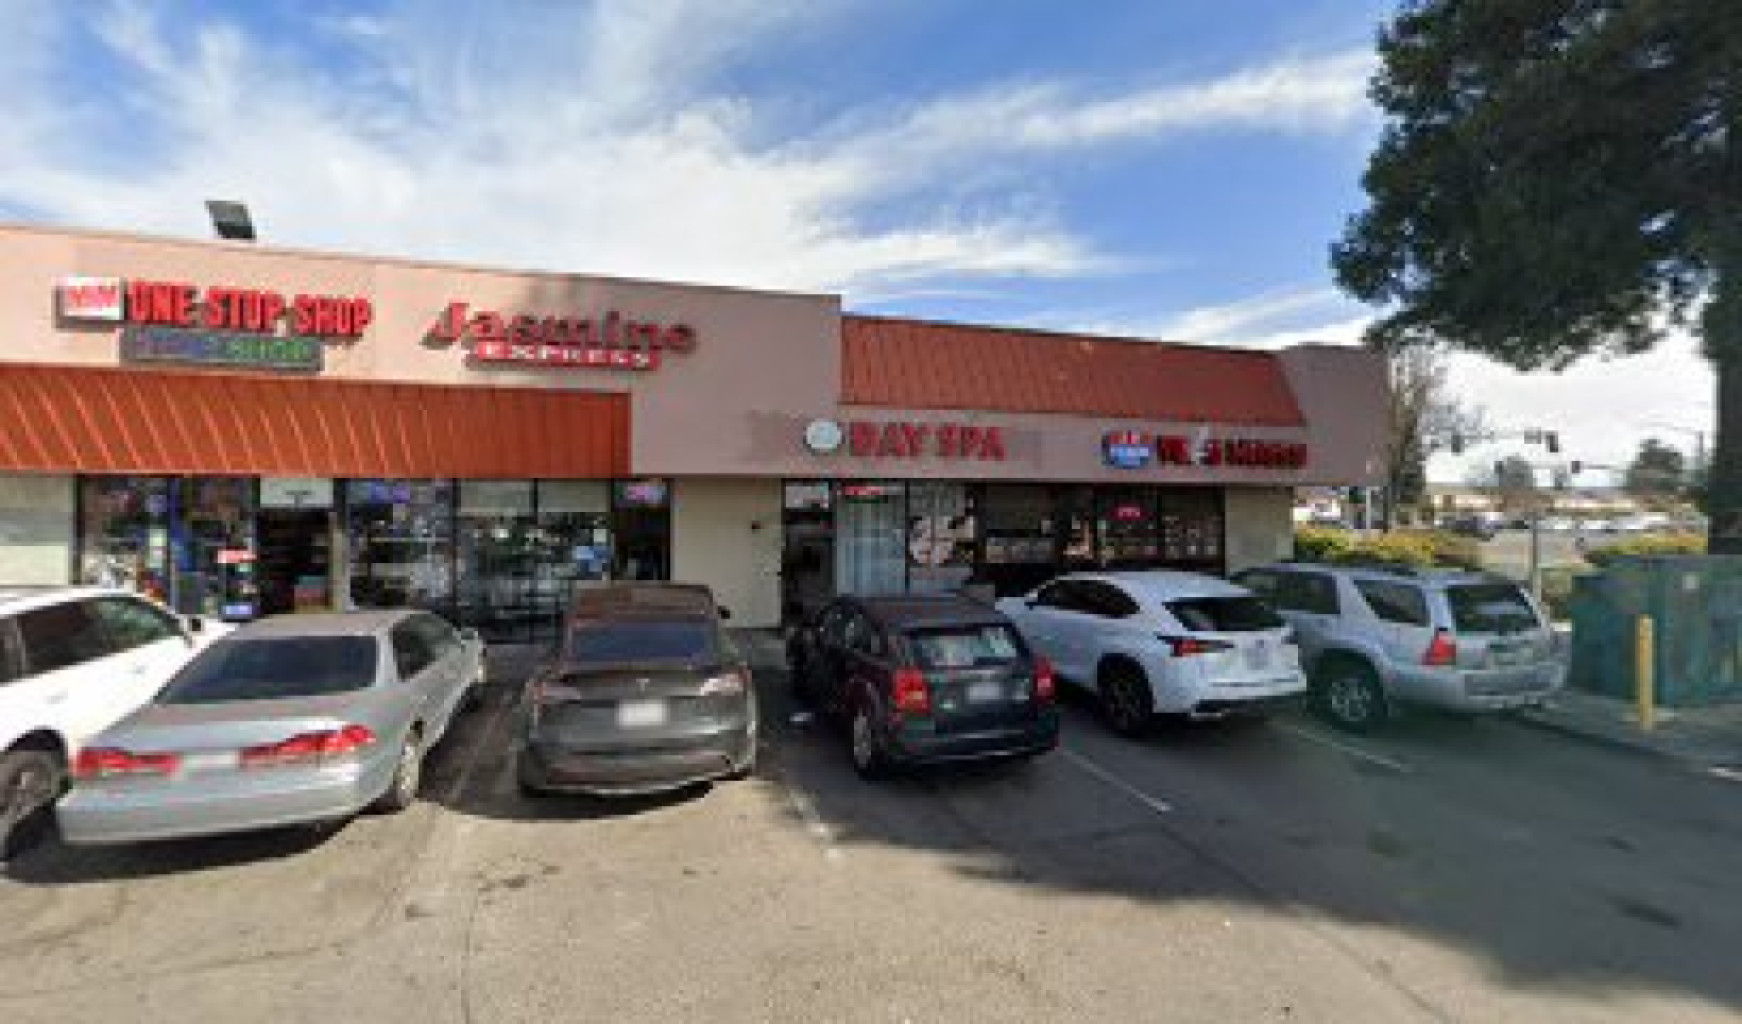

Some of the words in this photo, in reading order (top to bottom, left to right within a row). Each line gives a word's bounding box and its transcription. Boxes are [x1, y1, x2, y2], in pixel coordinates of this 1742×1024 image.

[131, 280, 196, 323] ONE
[204, 285, 286, 330] STOP
[293, 294, 373, 335] SHOP
[428, 303, 696, 352] Jasmine
[481, 342, 651, 367] EXPRESS
[849, 421, 926, 458] DAY
[935, 423, 1008, 461] SPA
